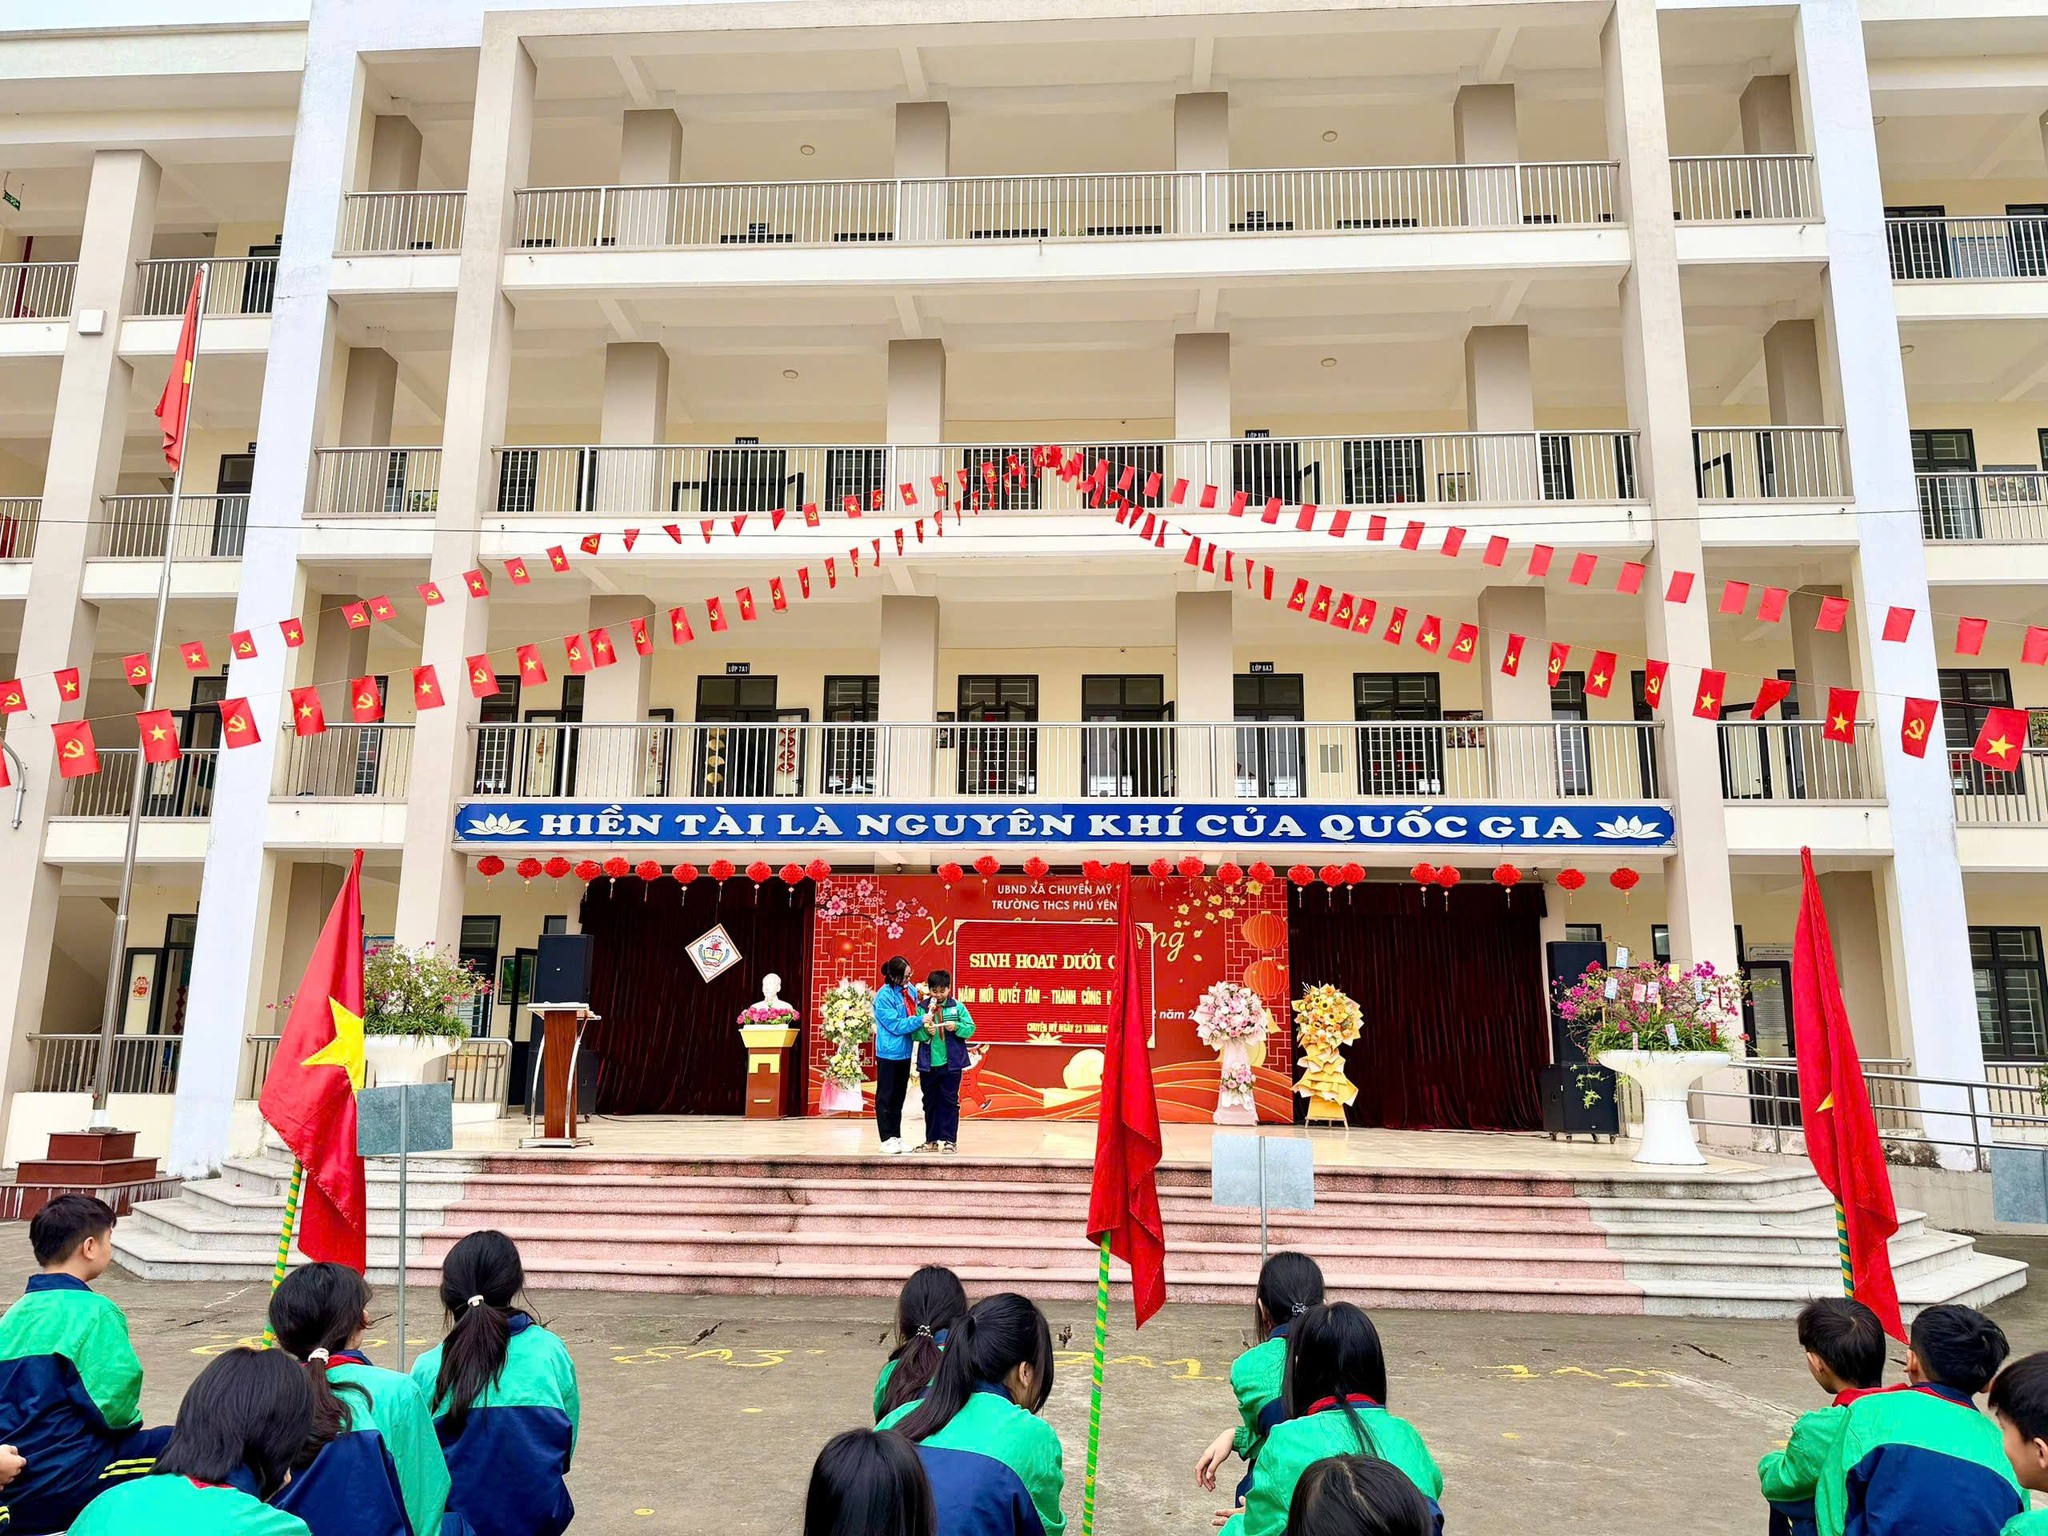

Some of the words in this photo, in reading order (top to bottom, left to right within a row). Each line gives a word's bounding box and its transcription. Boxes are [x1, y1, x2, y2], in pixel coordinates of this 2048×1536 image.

[539, 804, 663, 836] HIỀN
[675, 806, 765, 836] TÀI
[777, 806, 843, 836] LÀ
[857, 808, 1075, 836] NGUYÊN
[1088, 806, 1184, 836] KHÍ
[1196, 807, 1307, 837] CỦA
[1319, 805, 1468, 841] QUỐC
[1478, 816, 1583, 839] GIA
[997, 885, 1027, 895] UBND
[1030, 883, 1046, 895] XÃ
[1048, 884, 1093, 895] CHUYÊN
[1095, 884, 1112, 895] MỸ
[992, 898, 1040, 910] TRƯỜNG
[1042, 900, 1070, 911] THCS
[1072, 898, 1094, 911] PHÚ
[1097, 899, 1118, 911] YÊN
[969, 953, 1012, 968] SINH
[1062, 948, 1103, 970] DƯỚI
[998, 982, 1021, 1005] QUYẾT
[1025, 985, 1041, 1004] TÂM
[1051, 986, 1077, 1005] THÀNH
[1081, 986, 1102, 1006] CÔNG
[1159, 1008, 1185, 1020] năm
